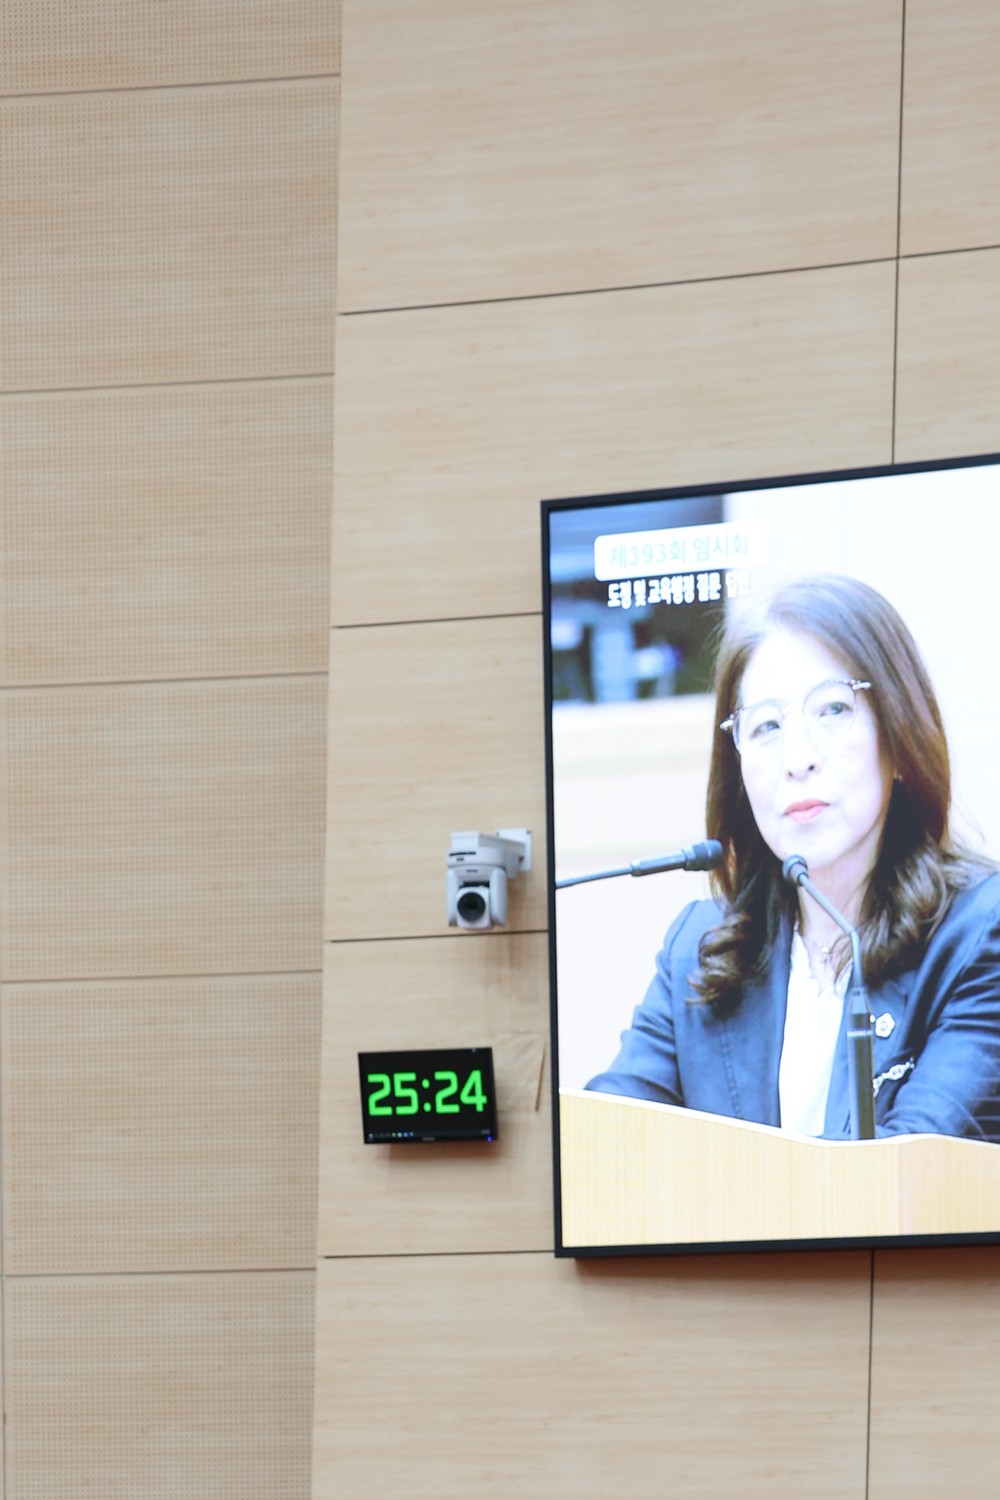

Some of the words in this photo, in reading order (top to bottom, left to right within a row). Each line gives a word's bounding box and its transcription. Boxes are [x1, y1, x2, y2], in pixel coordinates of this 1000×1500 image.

[608, 538, 687, 570] 제393회
[692, 533, 748, 562] 임시회
[367, 1069, 488, 1117] 25:24
